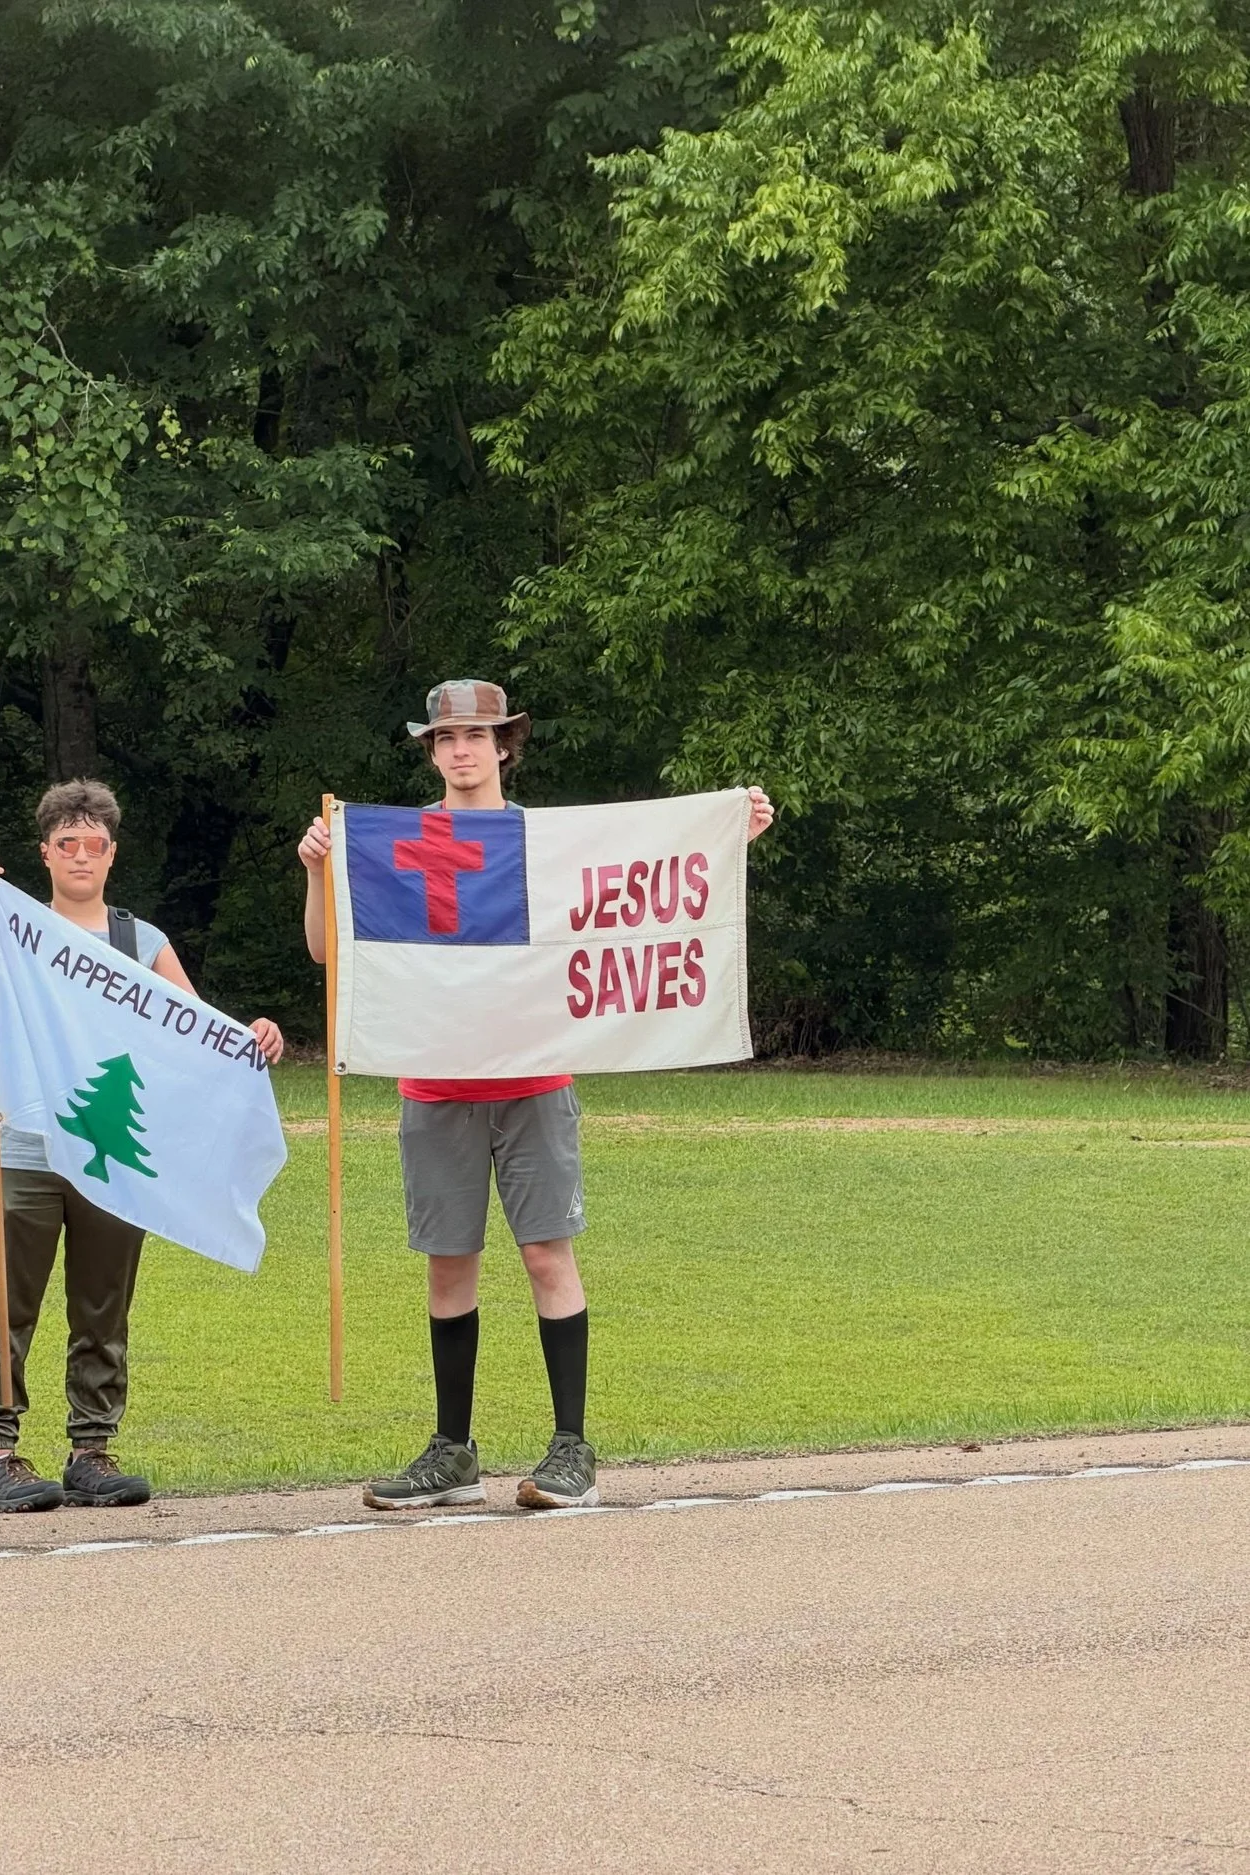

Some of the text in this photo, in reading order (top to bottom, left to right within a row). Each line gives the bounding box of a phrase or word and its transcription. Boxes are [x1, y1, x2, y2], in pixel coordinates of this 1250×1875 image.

[569, 852, 709, 932] JESUS
[8, 912, 42, 954] AN
[50, 945, 152, 1020] APPEAL
[161, 997, 197, 1036] TO
[566, 938, 707, 1019] SAVES
